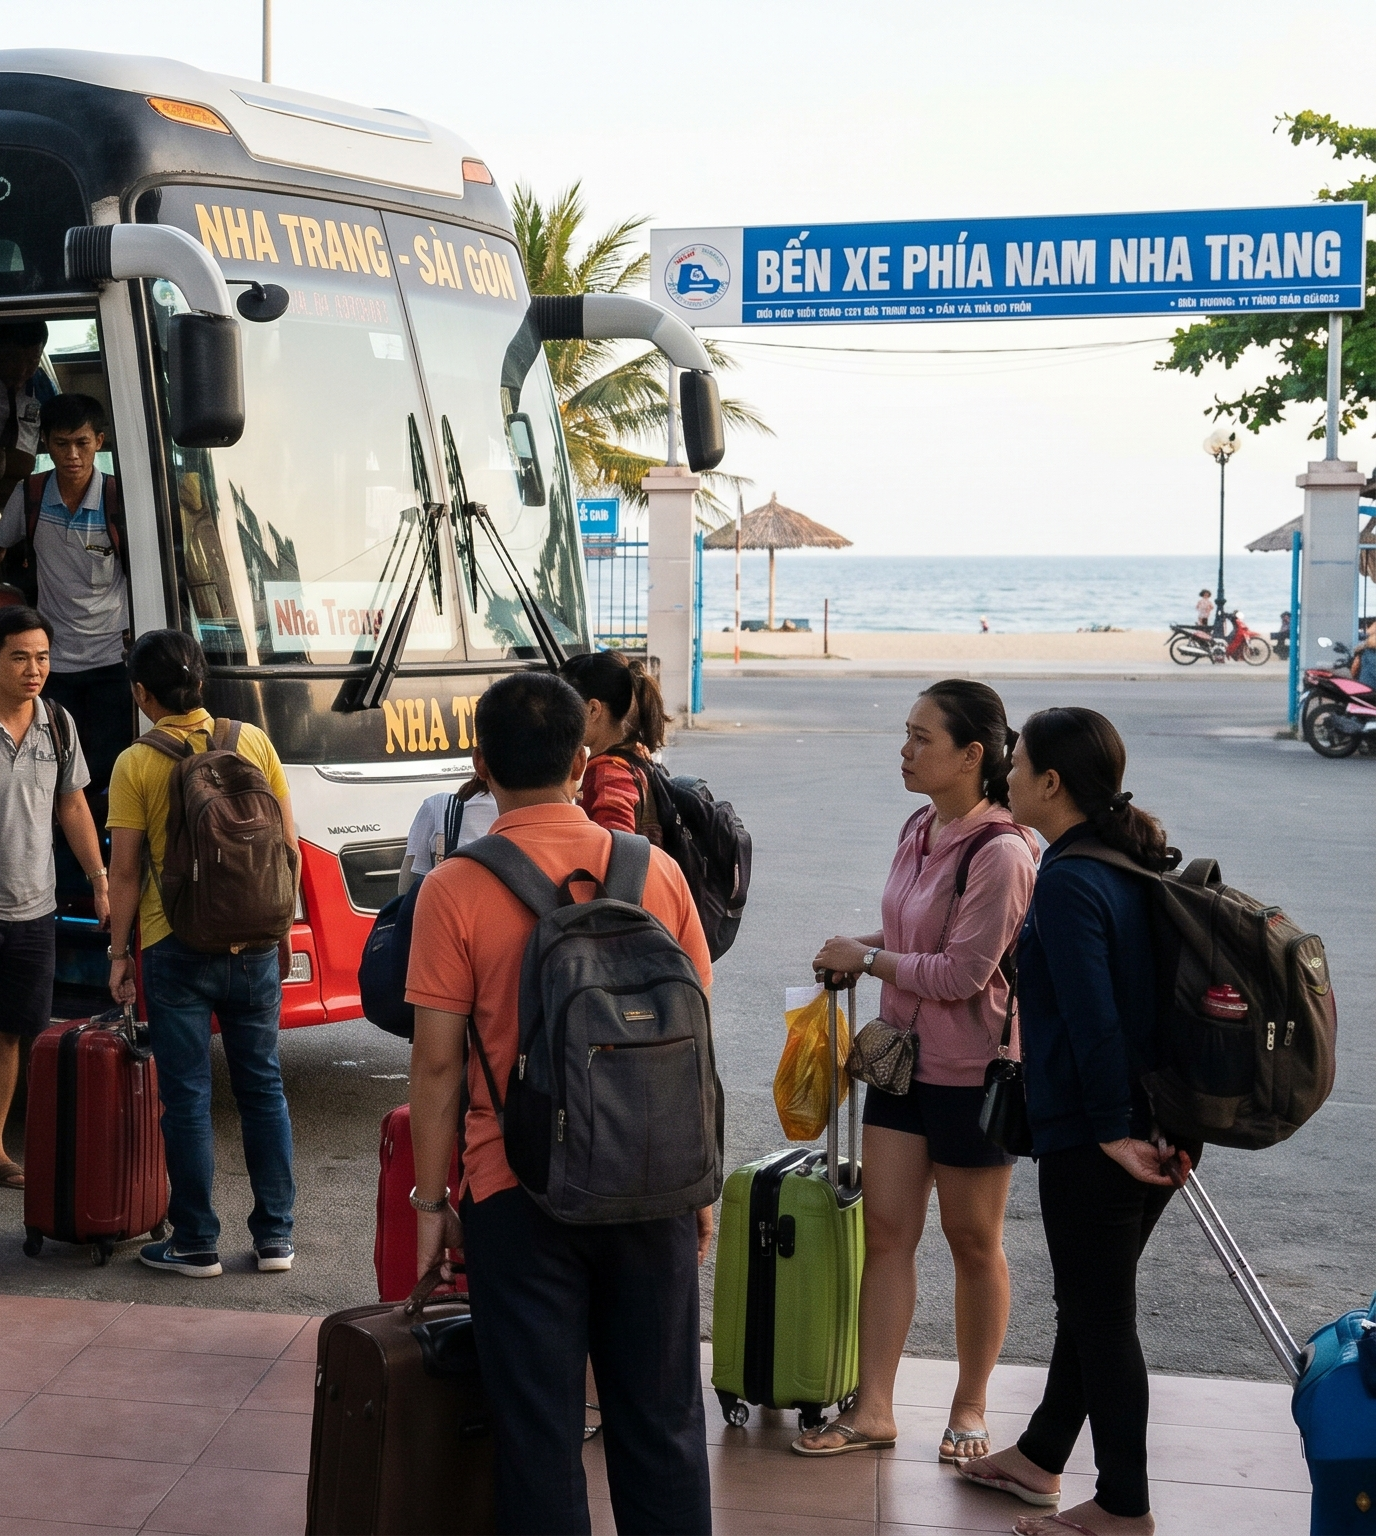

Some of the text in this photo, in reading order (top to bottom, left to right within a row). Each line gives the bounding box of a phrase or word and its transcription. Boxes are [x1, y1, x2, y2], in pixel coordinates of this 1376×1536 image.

[195, 204, 280, 264] NHA
[278, 213, 392, 279] TRANG
[413, 226, 464, 290] SÀI
[463, 238, 518, 301] GÒN
[756, 230, 832, 295] BẾN
[841, 246, 892, 292] XE
[902, 231, 994, 290] PHÍA
[1005, 238, 1097, 288] NAM
[1109, 236, 1194, 284] NHA
[1204, 230, 1342, 282] TRANG
[273, 599, 320, 637] Nha
[382, 697, 451, 755] NHA
